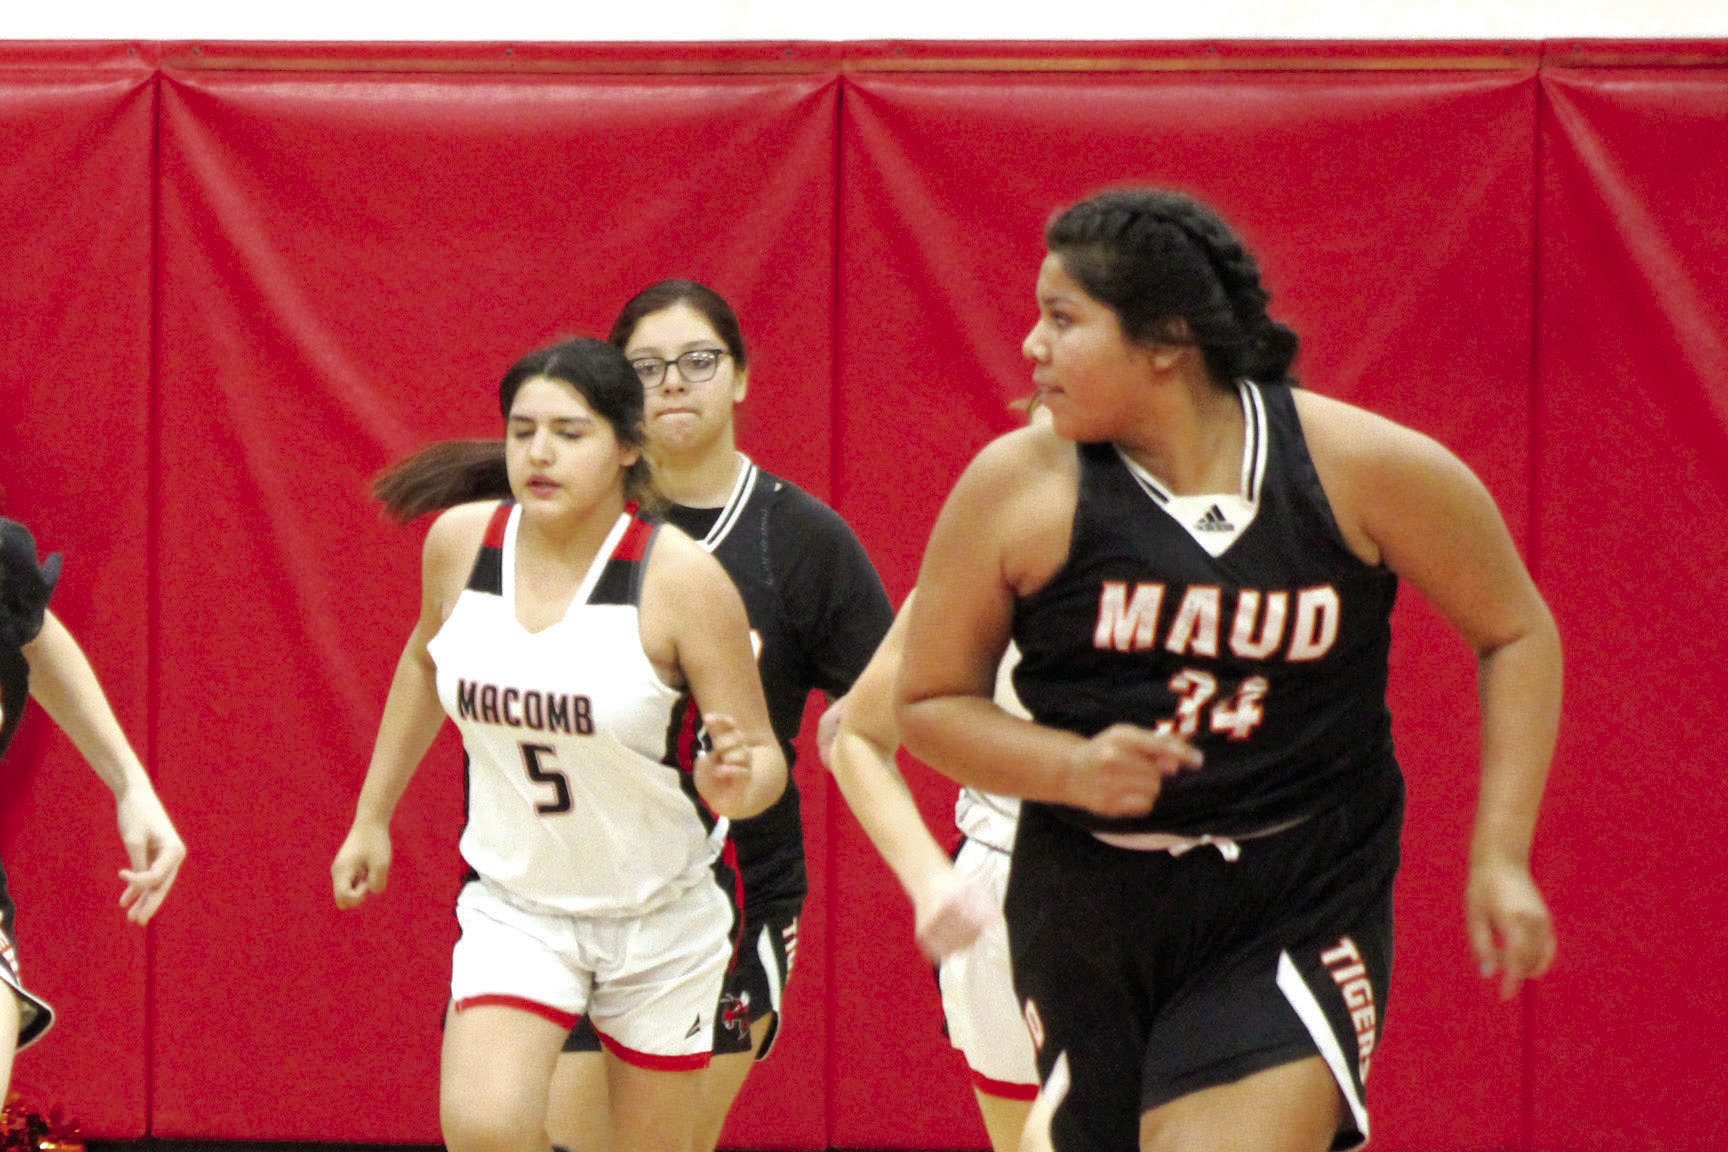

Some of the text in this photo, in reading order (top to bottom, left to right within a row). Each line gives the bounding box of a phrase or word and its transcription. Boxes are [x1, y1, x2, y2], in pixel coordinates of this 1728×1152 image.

[1093, 580, 1340, 662] MAUD
[456, 677, 596, 736] MACOMB
[1155, 668, 1268, 740] 34
[517, 741, 575, 818] 5
